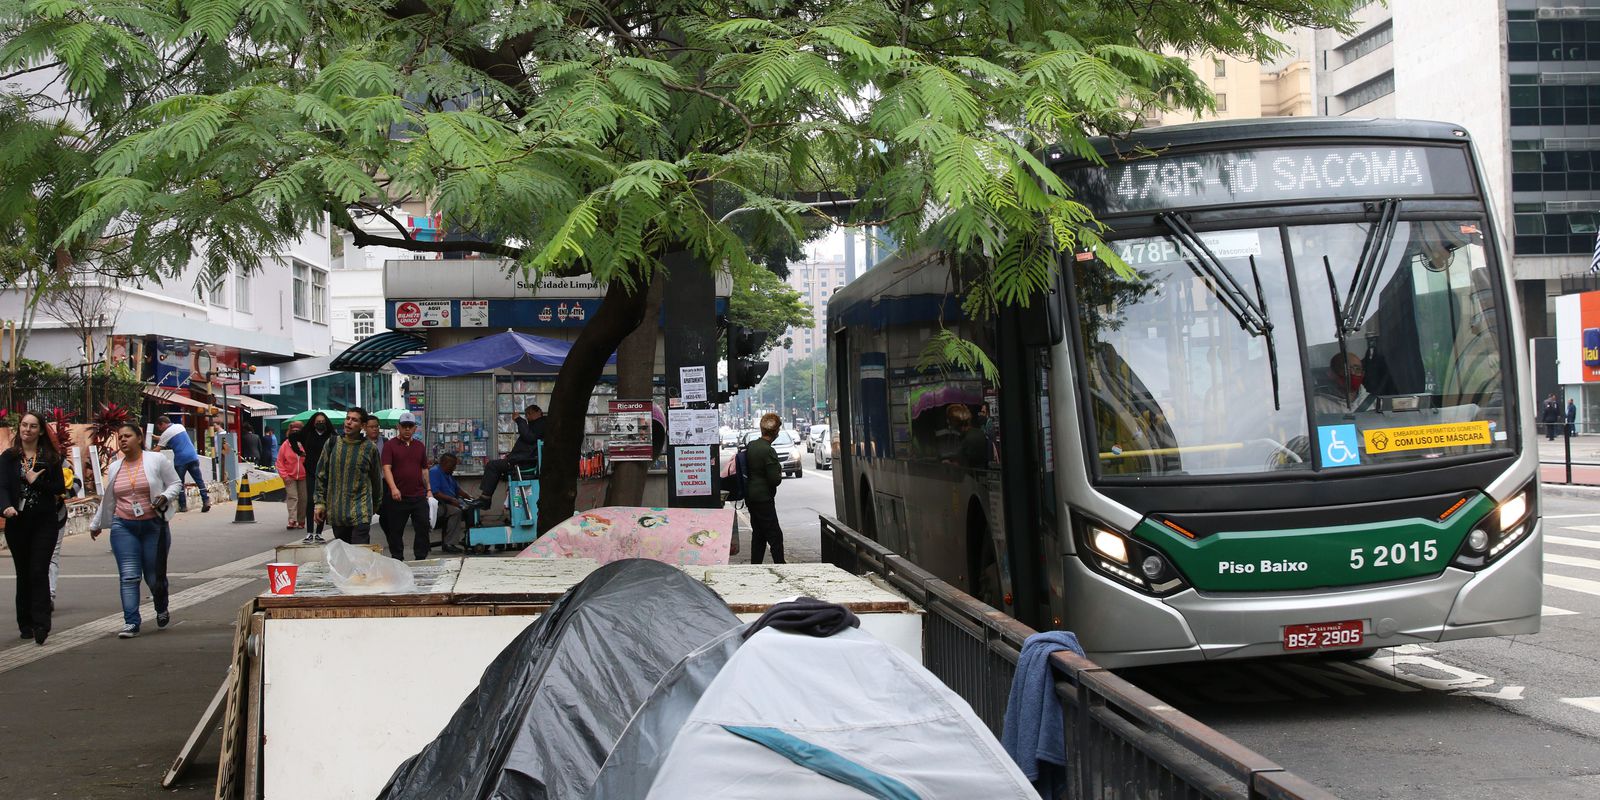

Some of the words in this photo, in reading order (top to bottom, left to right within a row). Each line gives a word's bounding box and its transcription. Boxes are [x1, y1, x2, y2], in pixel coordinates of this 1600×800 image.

[1117, 158, 1258, 200] 478P-10
[1272, 149, 1423, 191] SACOMA
[1121, 241, 1175, 265] 478P
[1219, 247, 1259, 256] Vasconcelos
[536, 280, 568, 288] Cidade
[1584, 346, 1598, 360] Itaú
[1394, 429, 1424, 437] EMBARQUE
[1395, 438, 1414, 447] COM
[1446, 432, 1484, 442] MÁSCARA
[1350, 548, 1364, 569] 5
[1374, 540, 1438, 567] 2015
[1218, 561, 1255, 574] Piso
[1260, 560, 1308, 572] Baixo
[1288, 632, 1317, 647] BSZ
[1322, 630, 1359, 645] 2905
